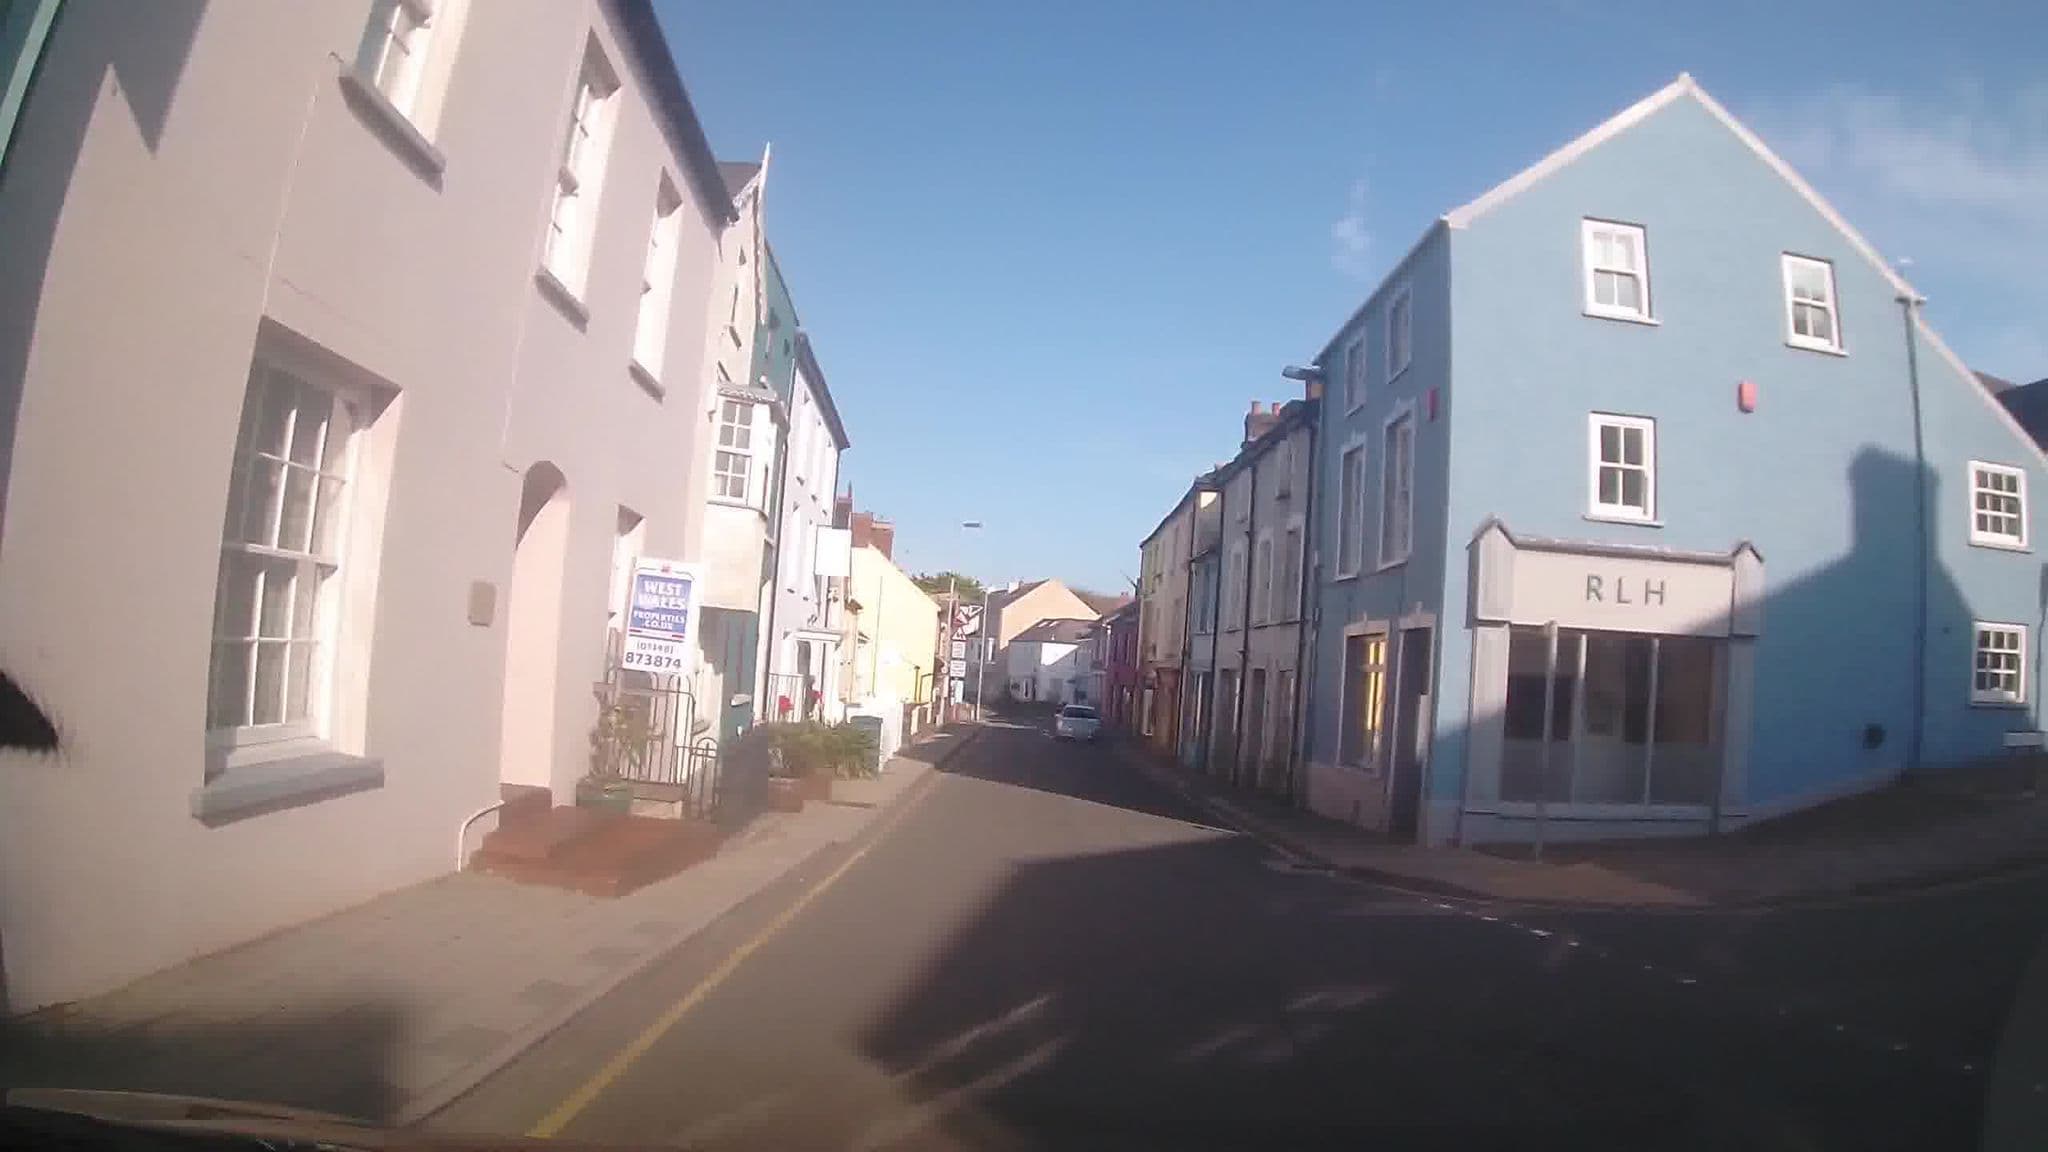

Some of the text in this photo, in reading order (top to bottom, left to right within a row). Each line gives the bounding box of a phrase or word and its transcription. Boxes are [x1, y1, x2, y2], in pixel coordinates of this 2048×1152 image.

[644, 581, 682, 596] WEST
[1586, 574, 1665, 605] RLH
[625, 652, 681, 668] 873874
